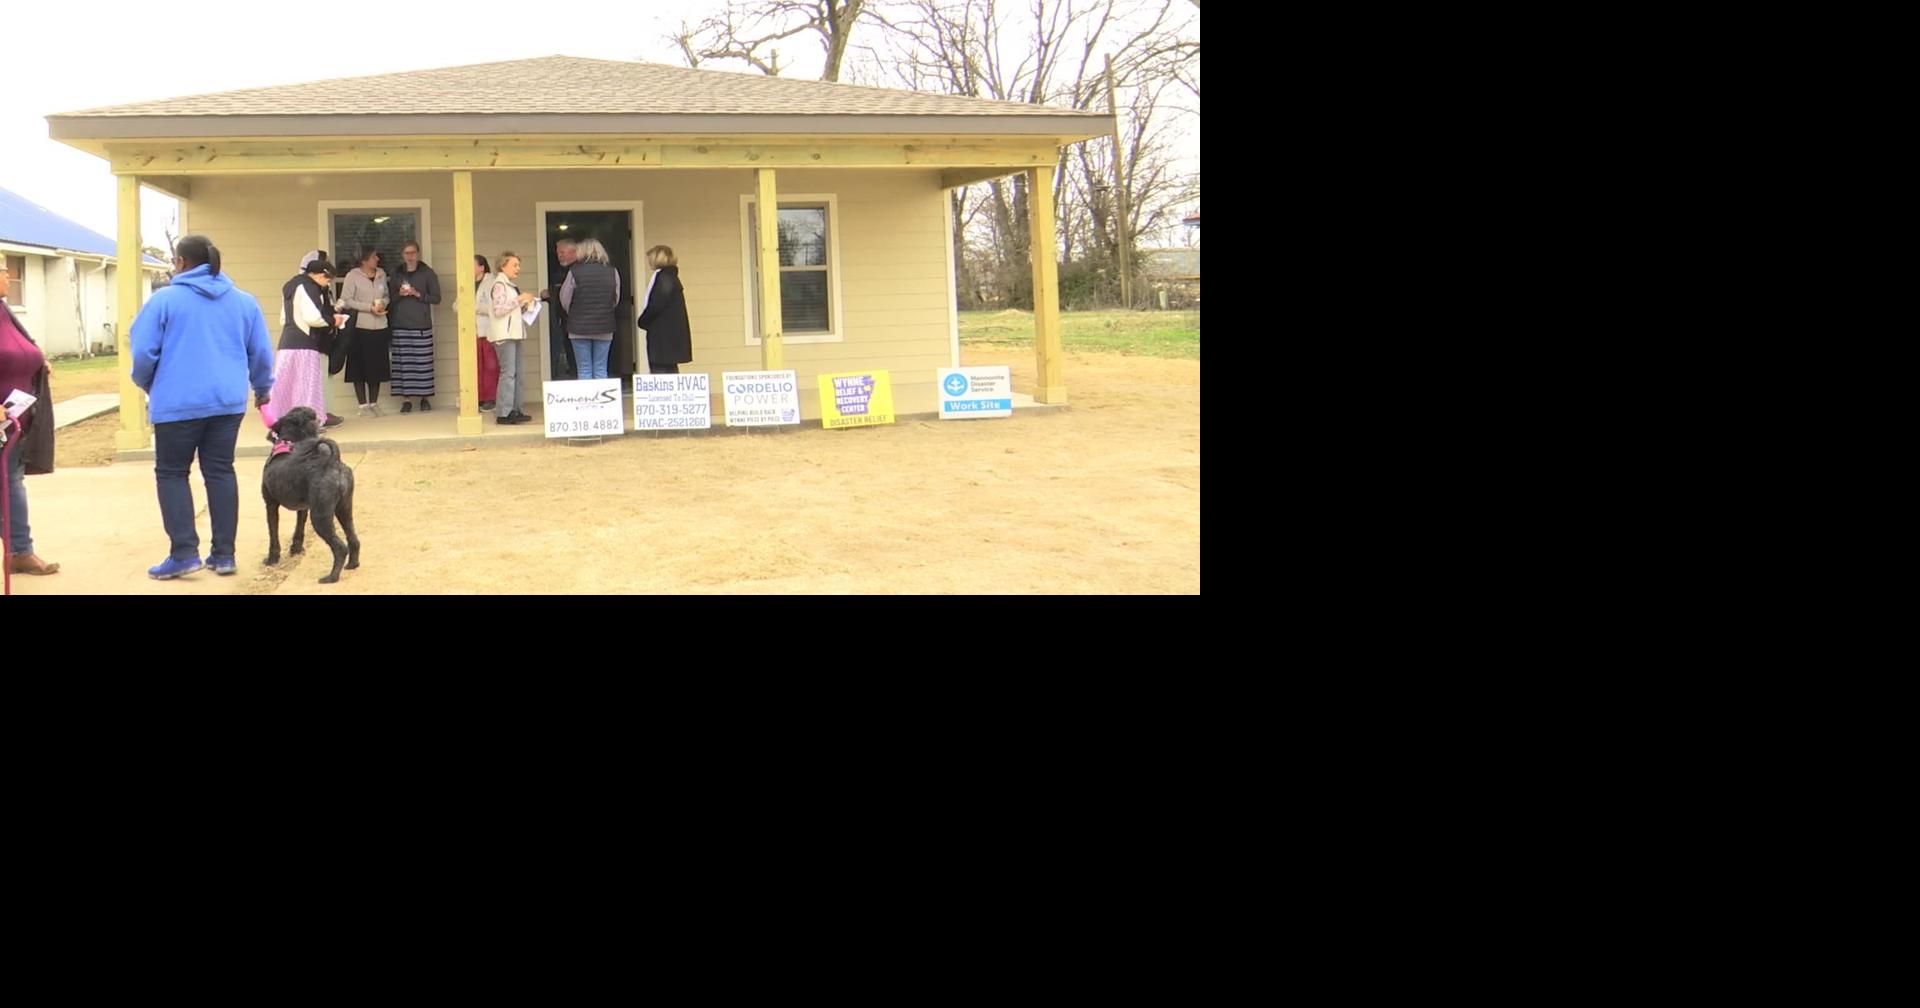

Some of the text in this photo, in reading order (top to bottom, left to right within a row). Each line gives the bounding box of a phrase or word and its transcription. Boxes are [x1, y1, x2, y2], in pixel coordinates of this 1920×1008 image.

[635, 375, 706, 392] Baskins HVAC
[727, 382, 793, 394] CORDELIO
[834, 376, 864, 388] WYNNE
[836, 388, 857, 396] RELIEF
[547, 391, 600, 406] Diamond
[734, 393, 789, 405] POWER
[837, 396, 868, 405] RECOVERY
[636, 403, 707, 416] 870-319-5277
[842, 405, 866, 413] CENTER
[950, 400, 1000, 410] Work Site
[549, 419, 619, 433] 870.318.4882
[639, 417, 706, 428] HVAC-2521260
[830, 414, 887, 426] DISASTER RELIEF
